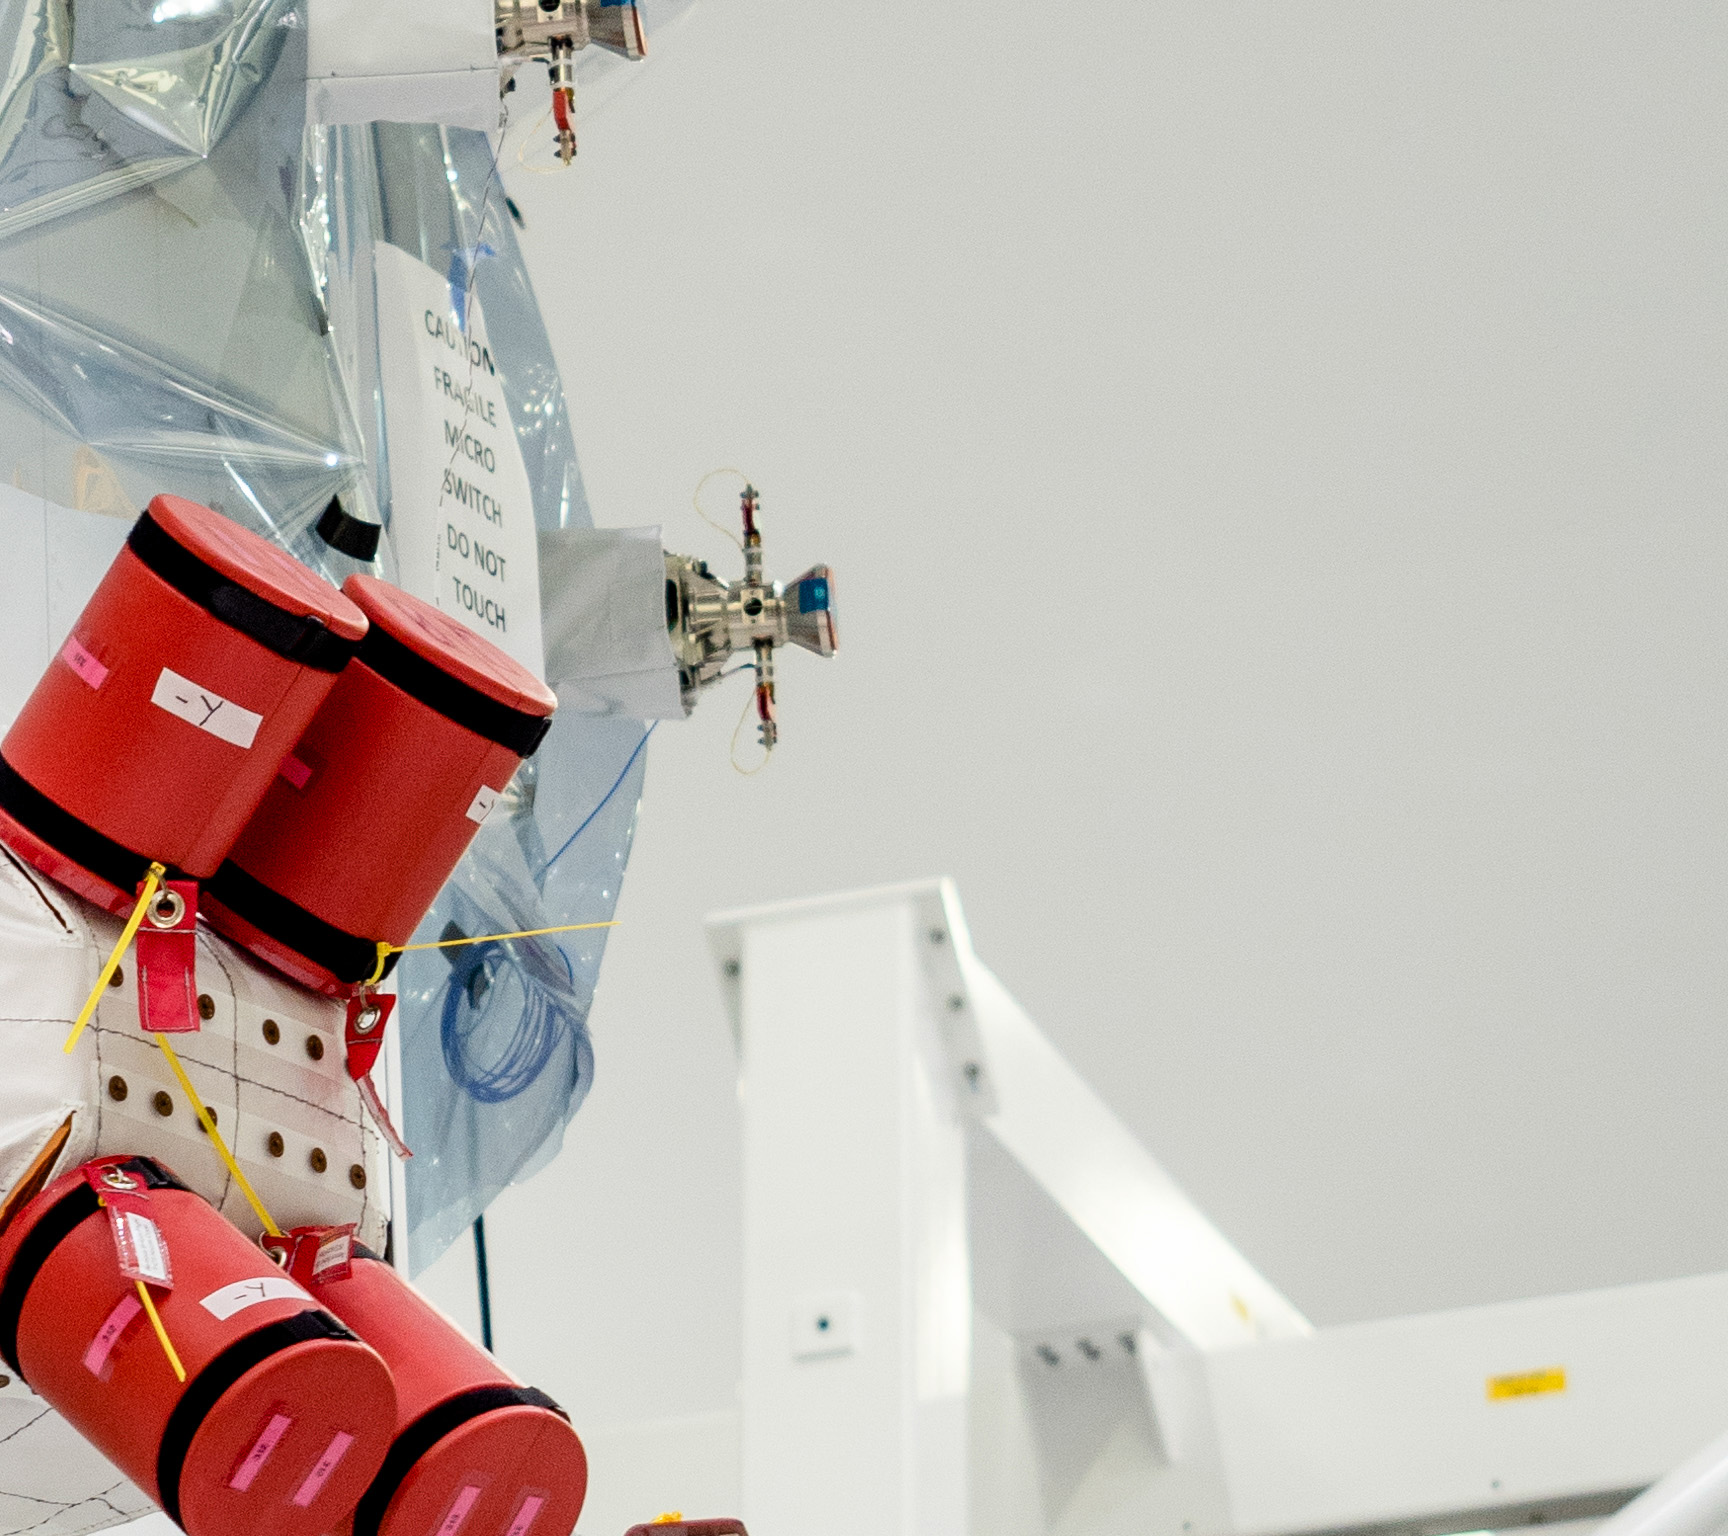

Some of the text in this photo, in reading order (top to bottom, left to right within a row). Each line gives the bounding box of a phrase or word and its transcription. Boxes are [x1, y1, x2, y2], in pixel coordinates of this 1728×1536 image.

[444, 418, 495, 474] MICRO
[444, 467, 503, 529] SWITCH
[447, 522, 469, 559] DO
[474, 540, 506, 583] NOT
[453, 576, 506, 633] TOUCH
